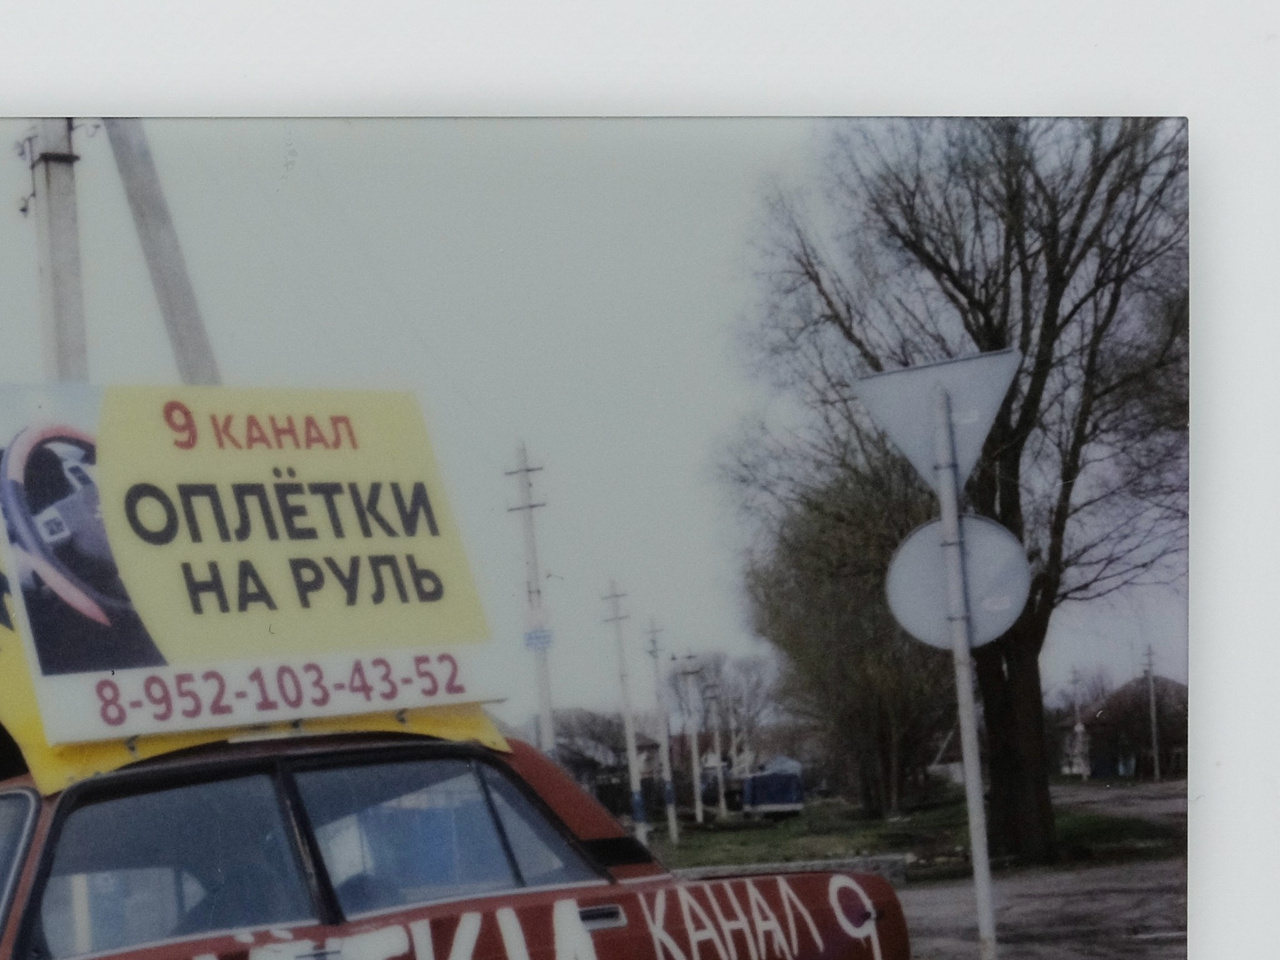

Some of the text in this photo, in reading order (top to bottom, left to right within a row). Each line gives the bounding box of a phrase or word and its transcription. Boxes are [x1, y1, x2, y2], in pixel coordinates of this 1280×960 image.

[163, 400, 359, 450] 9 КАНАЛ
[124, 467, 440, 545] ОПЛЁТКИ
[181, 555, 445, 615] НА РУЛЬ
[95, 652, 467, 726] 8-952-103-43-52
